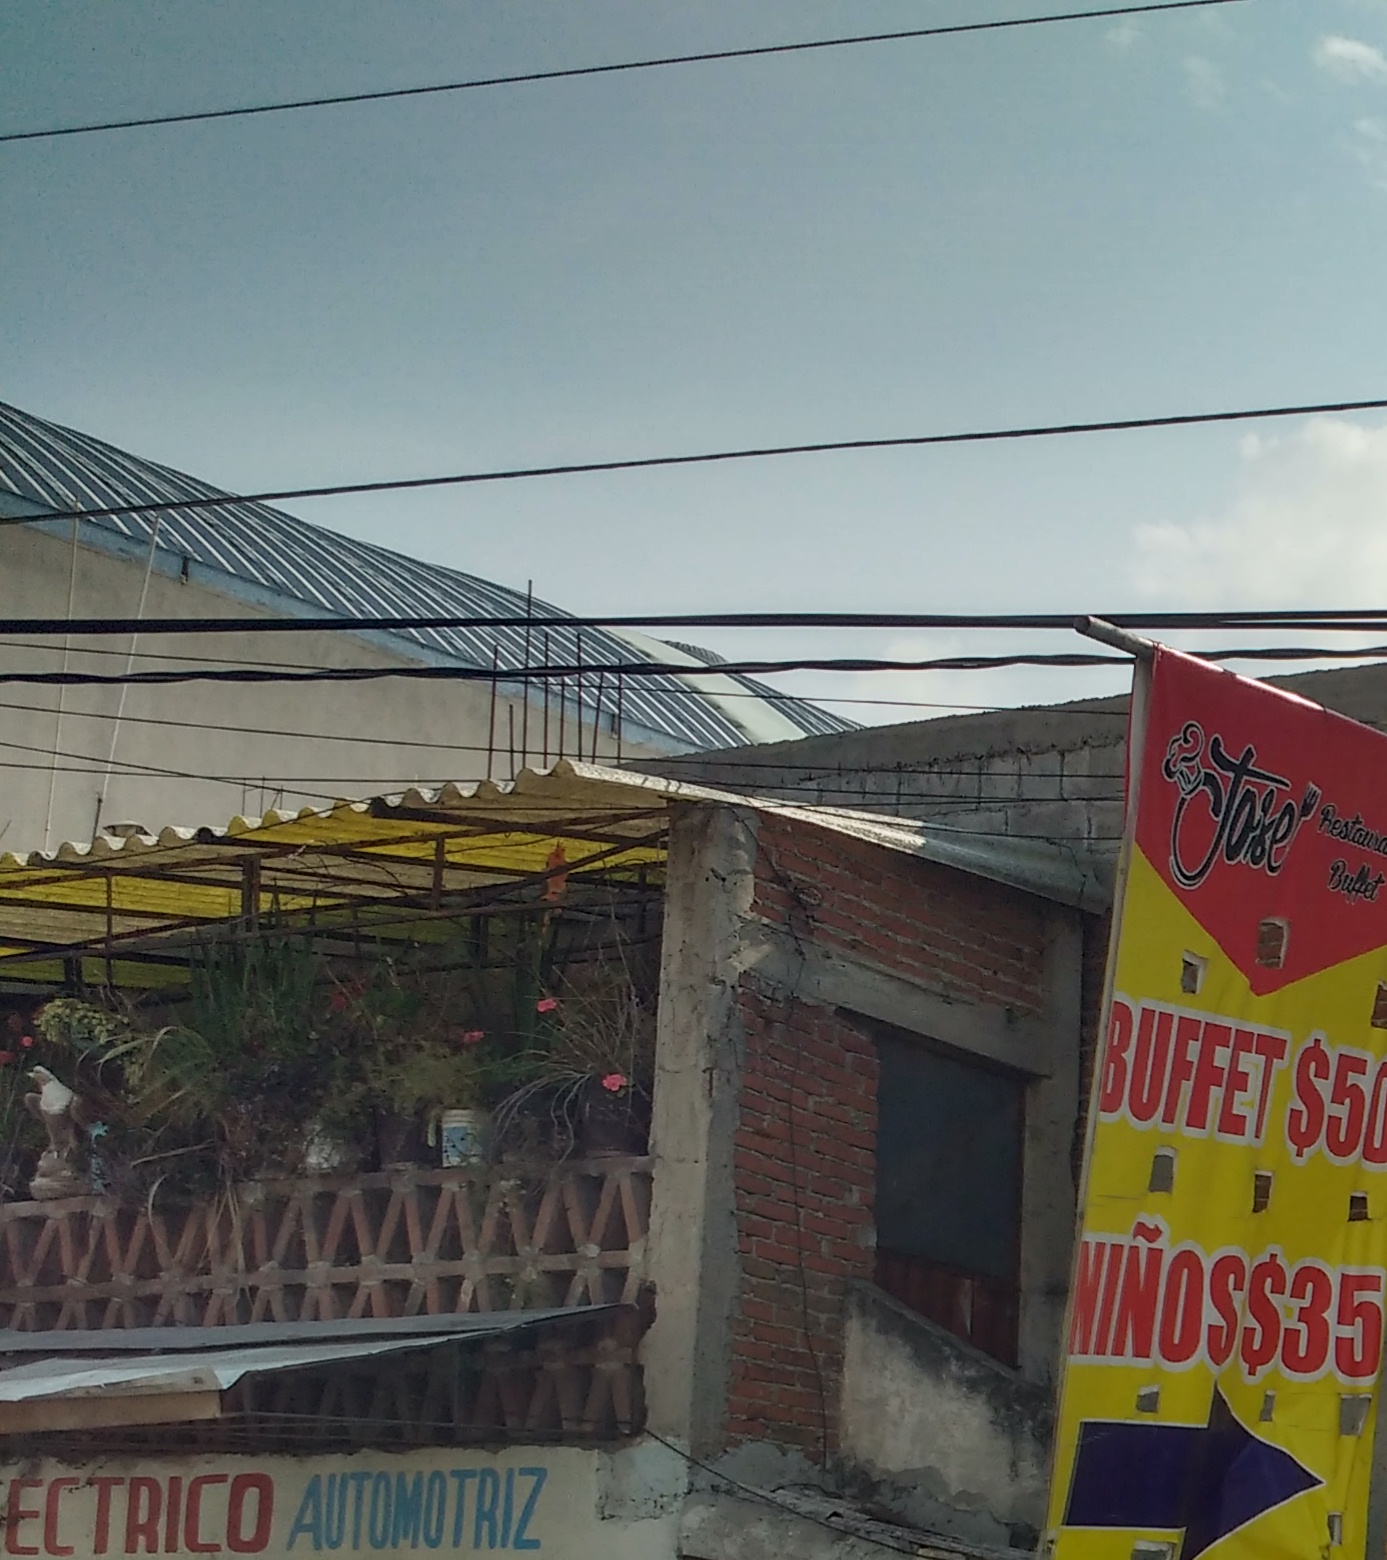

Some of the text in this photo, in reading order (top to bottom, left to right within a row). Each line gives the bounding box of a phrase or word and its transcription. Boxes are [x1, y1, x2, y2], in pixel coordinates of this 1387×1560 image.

[1328, 859, 1384, 904] Buffet
[1099, 998, 1288, 1140] BUFFET
[4, 1466, 548, 1556] ECTRICO AUTOMOTRIZ
